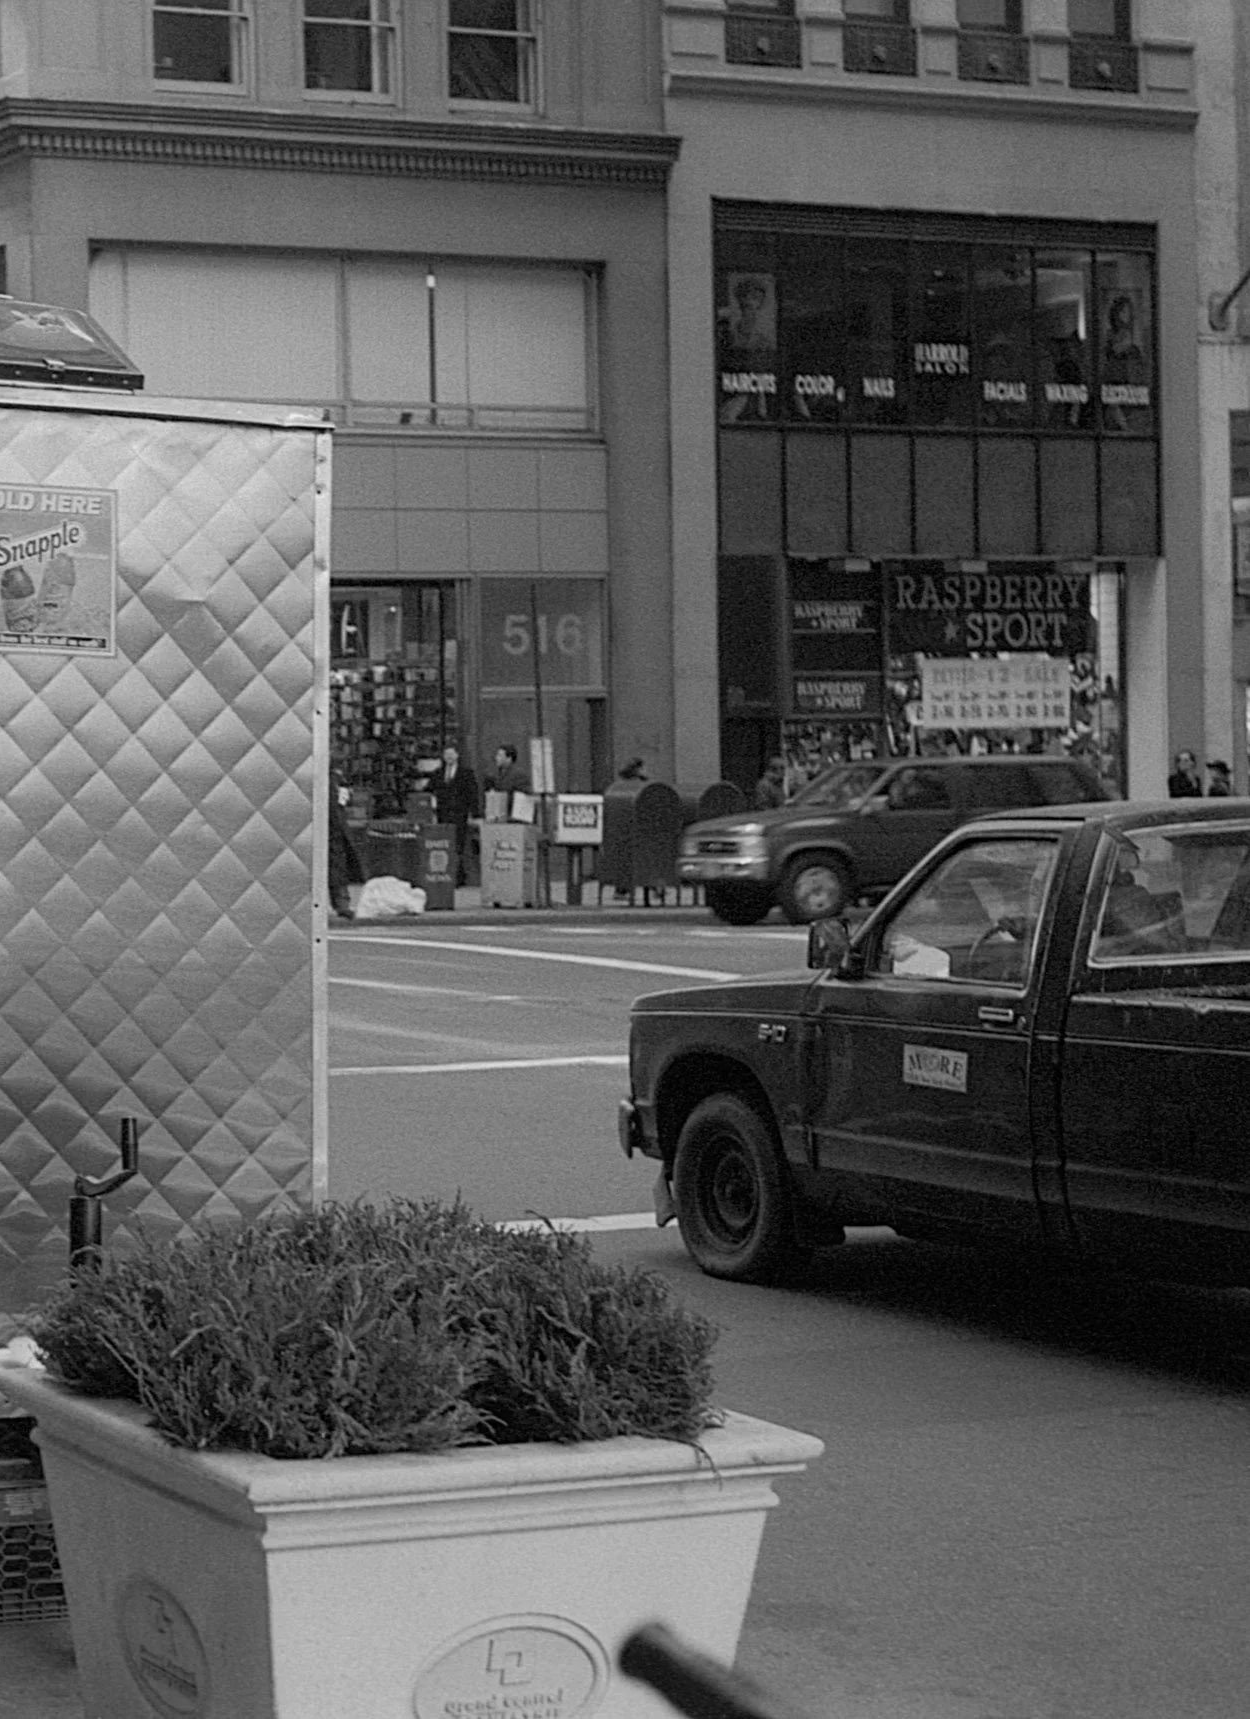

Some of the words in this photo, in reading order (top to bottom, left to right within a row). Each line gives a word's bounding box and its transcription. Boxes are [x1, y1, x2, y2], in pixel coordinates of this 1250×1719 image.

[914, 361, 969, 375] SALON
[722, 372, 777, 394] HAIRCUTS
[795, 374, 834, 395] COLOR
[862, 377, 895, 398] NAILS
[983, 381, 1027, 401] FACIALS
[1044, 384, 1088, 404] WAXING
[41, 493, 102, 516] HERE
[895, 574, 1087, 611] RASPBERRY
[502, 613, 583, 656] 516
[965, 611, 1067, 648] SPORT
